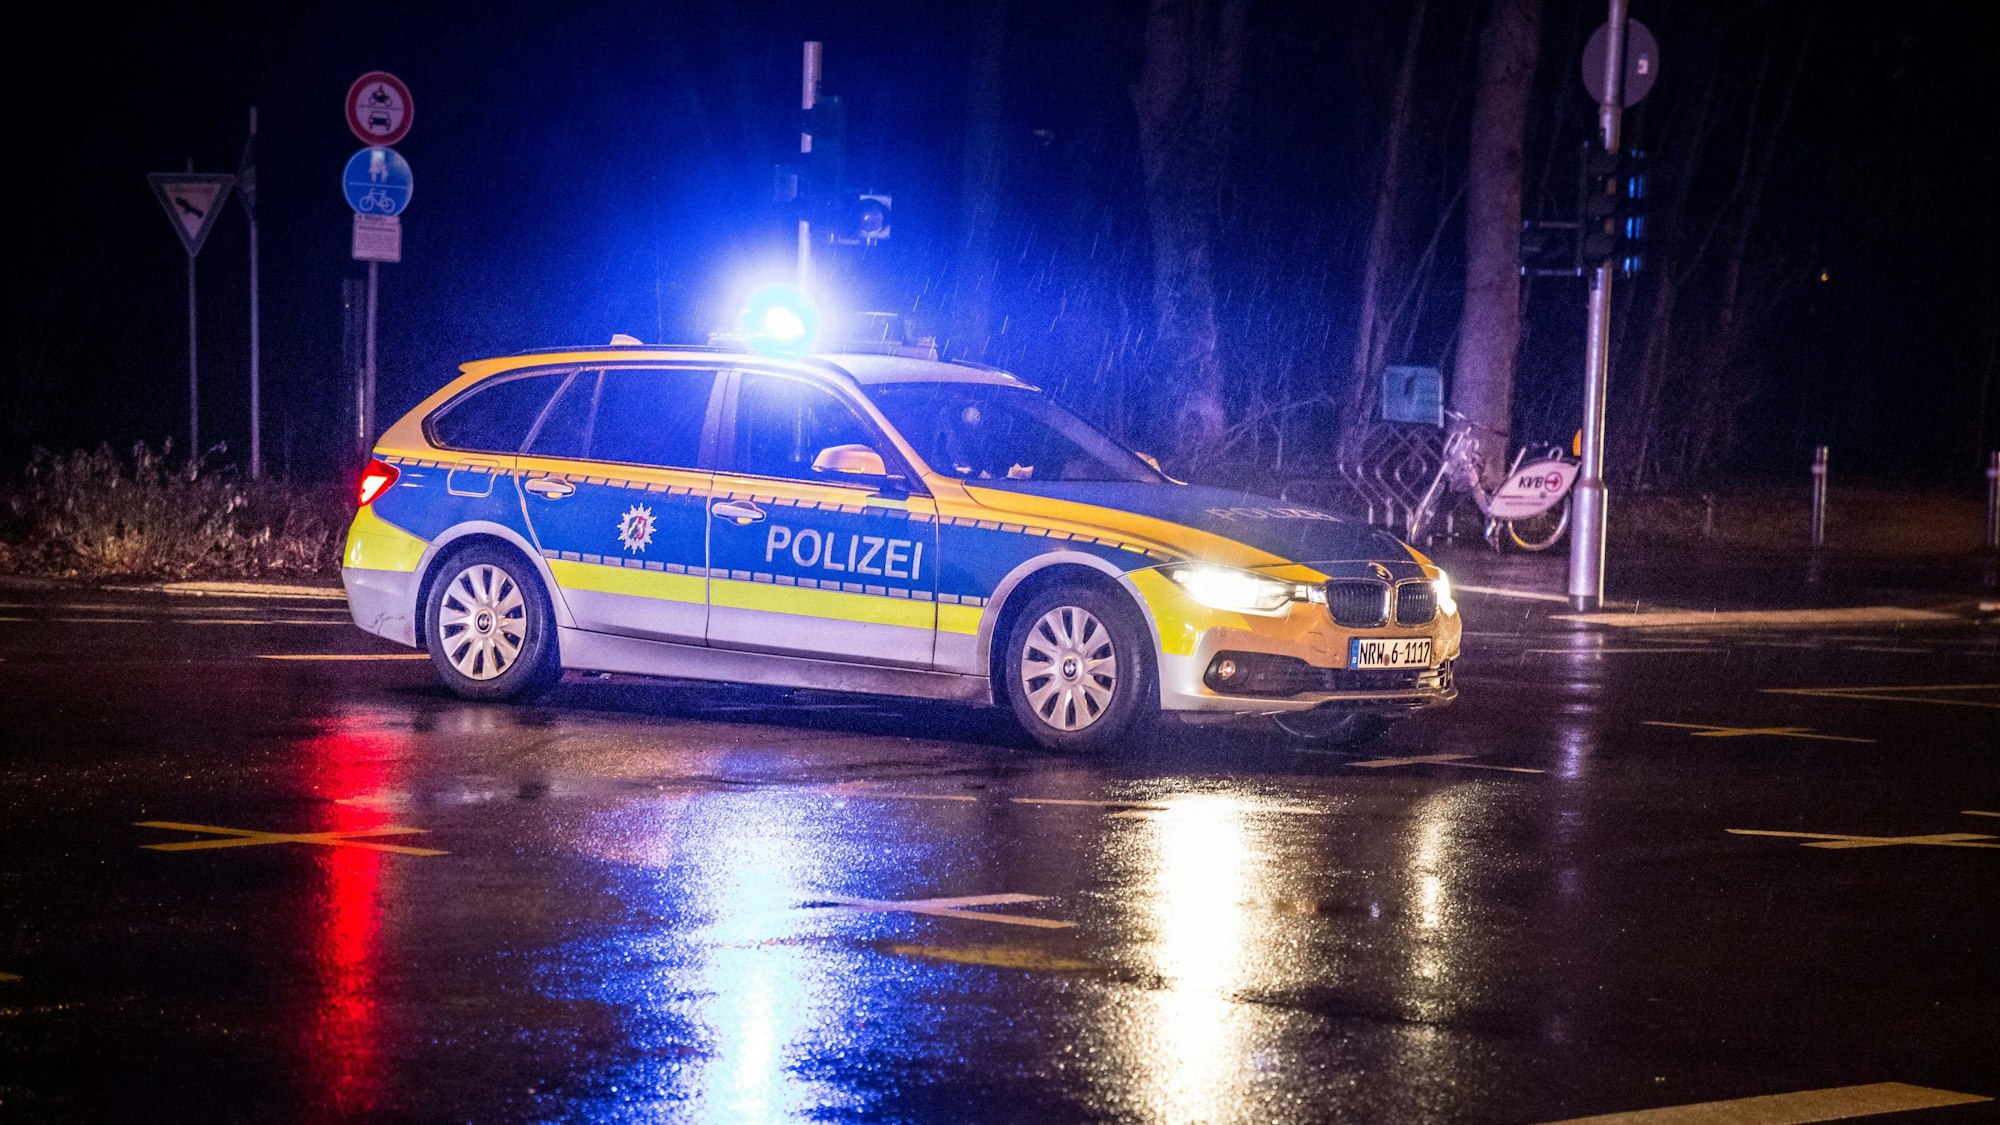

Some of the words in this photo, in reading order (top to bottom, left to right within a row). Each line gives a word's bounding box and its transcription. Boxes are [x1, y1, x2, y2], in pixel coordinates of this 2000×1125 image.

[1519, 476, 1544, 489] KVB
[765, 525, 923, 580] POLIZEI
[1359, 642, 1385, 665] NRW
[1391, 641, 1430, 664] 6-1117
